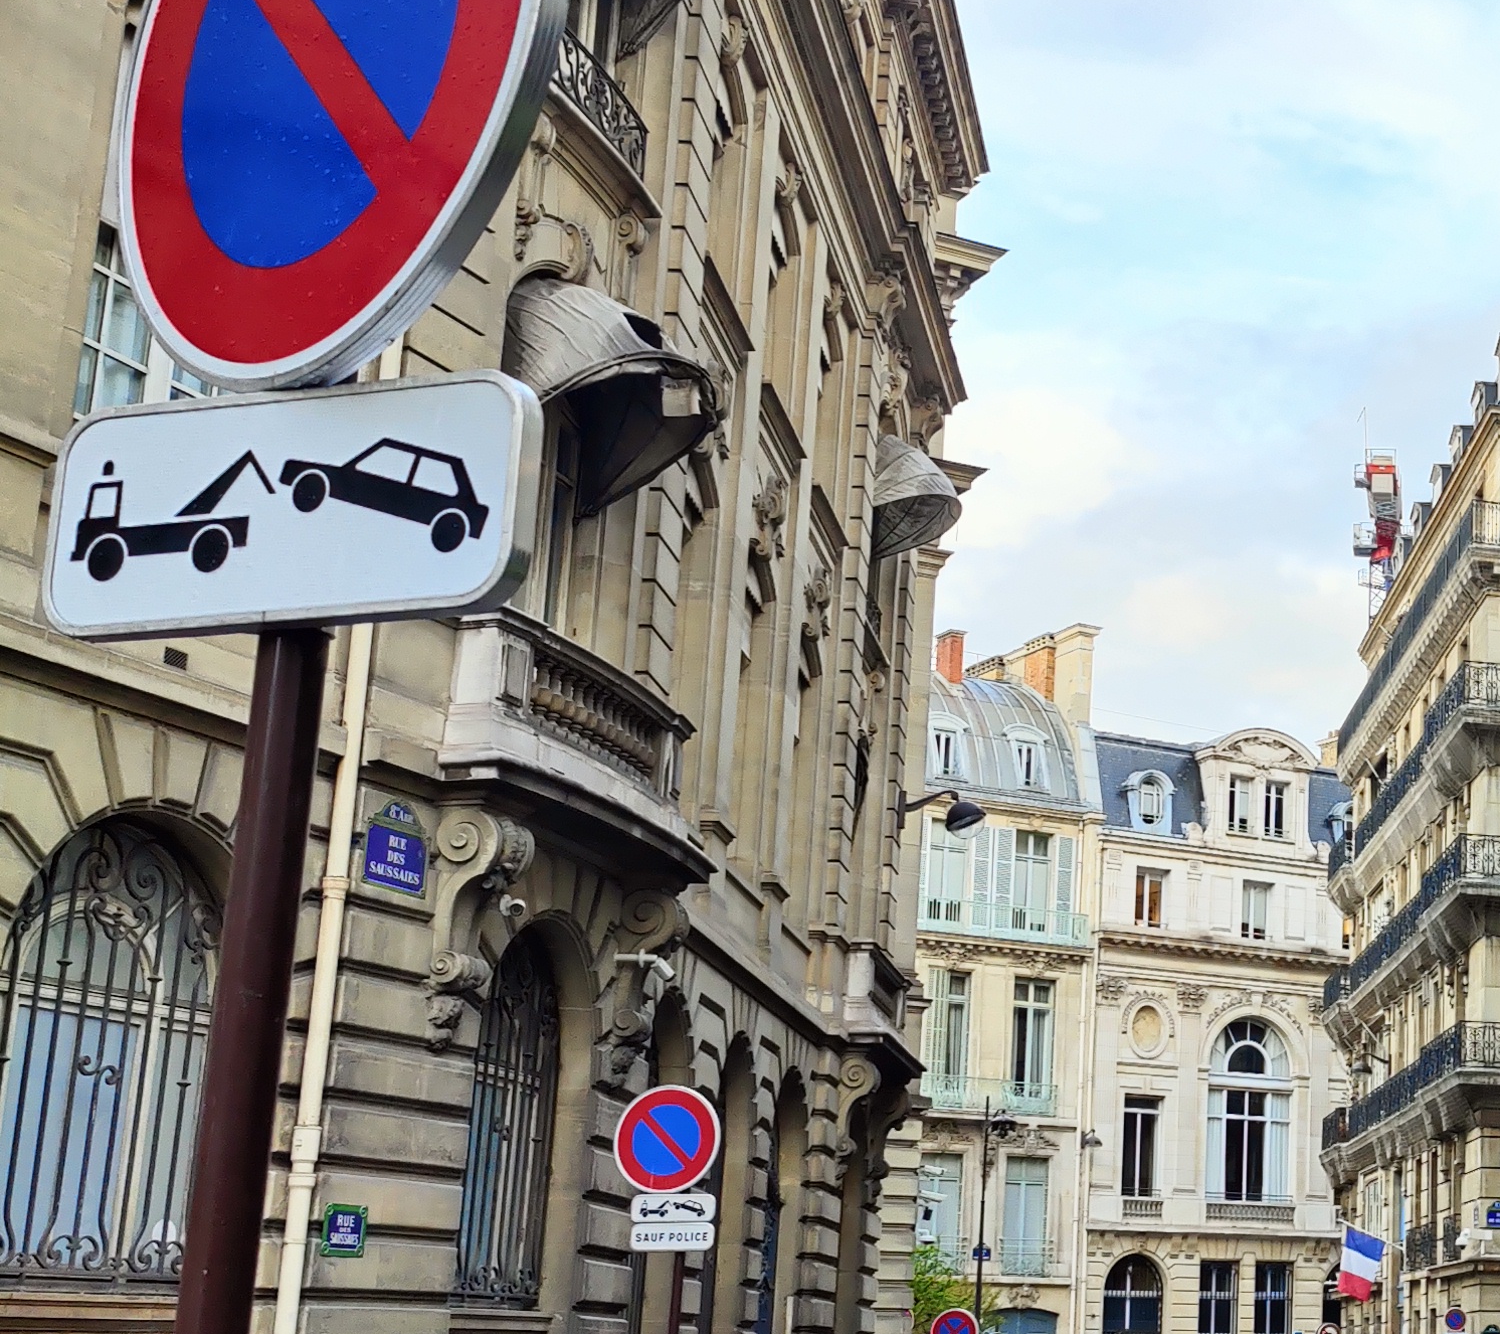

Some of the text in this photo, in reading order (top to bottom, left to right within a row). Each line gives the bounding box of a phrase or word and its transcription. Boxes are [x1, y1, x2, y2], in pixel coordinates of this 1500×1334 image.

[388, 834, 408, 851] RUE
[386, 849, 406, 866] DES
[368, 860, 421, 886] SAUSSAIES
[337, 1213, 356, 1227] RUE
[635, 1231, 709, 1243] SAUF POLICE
